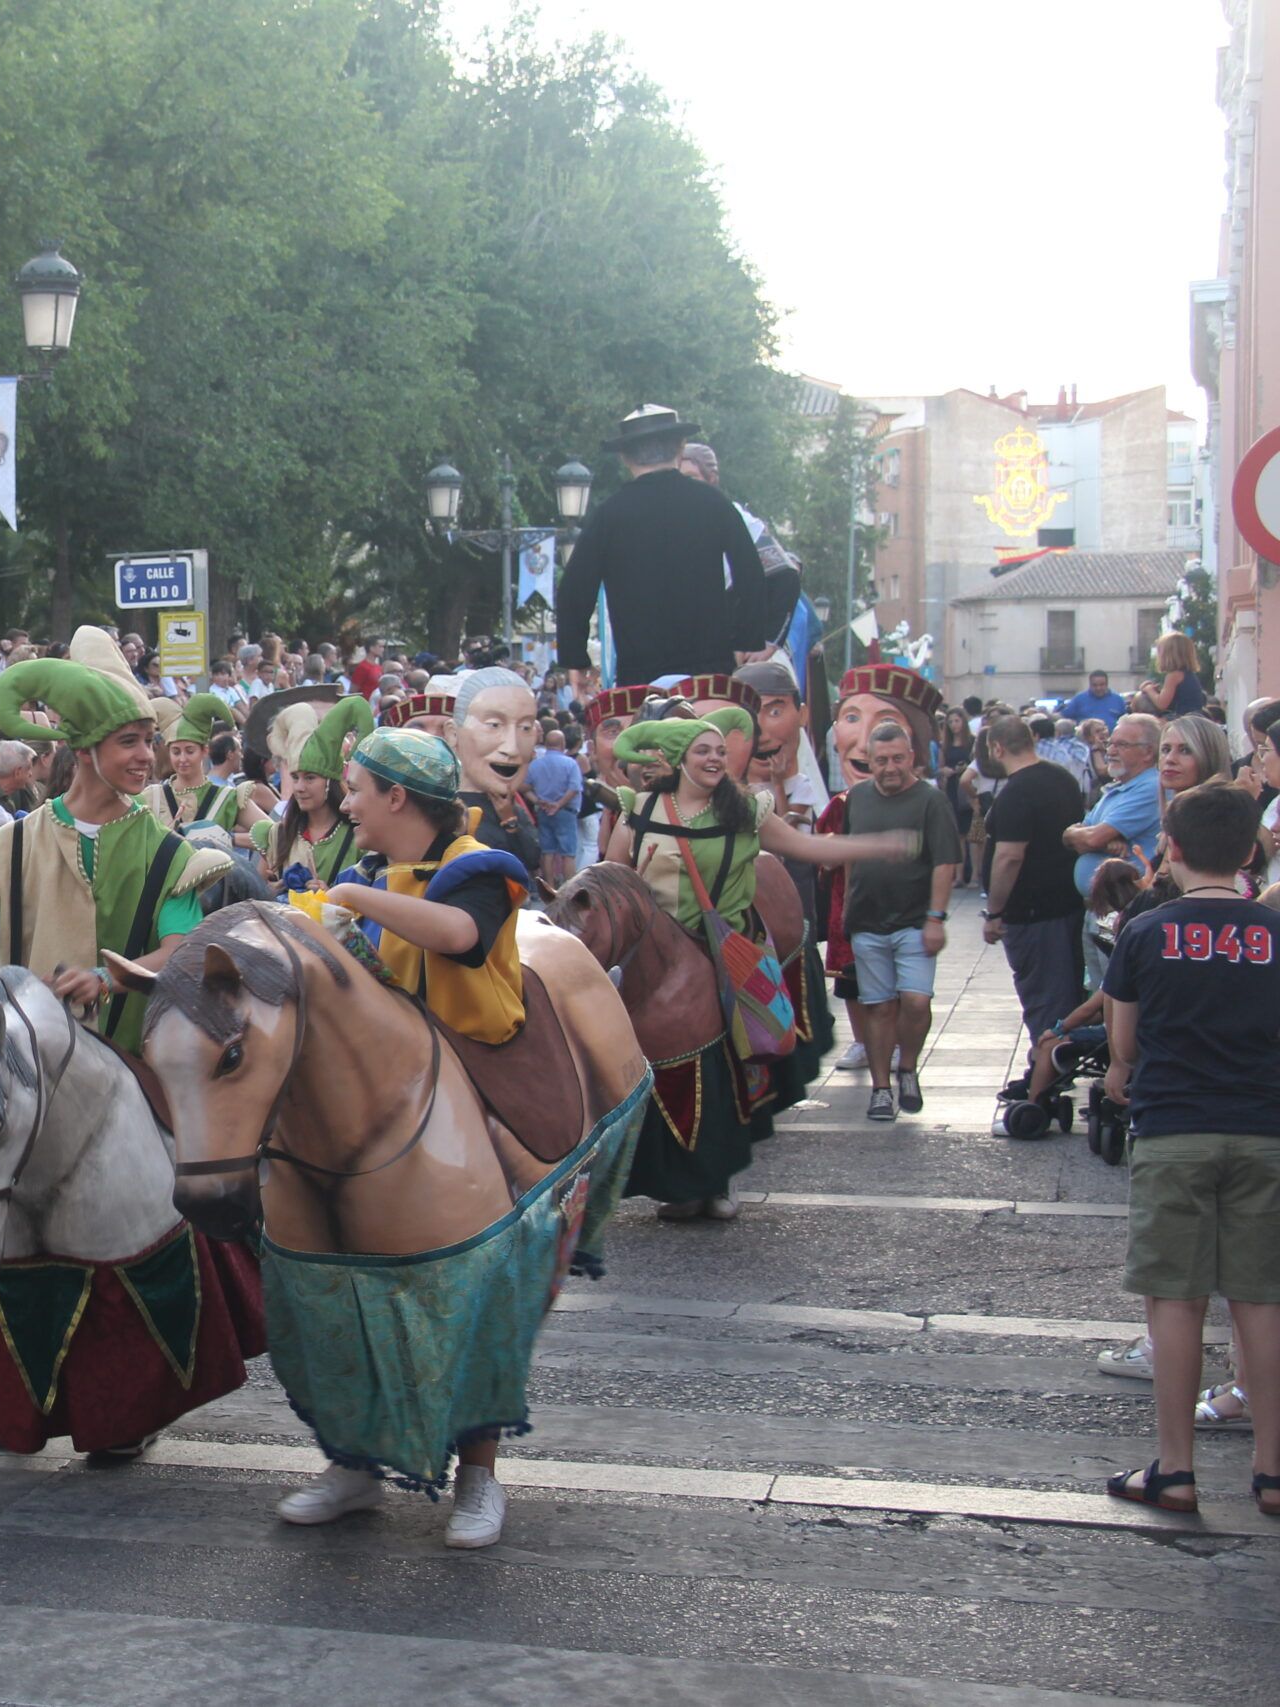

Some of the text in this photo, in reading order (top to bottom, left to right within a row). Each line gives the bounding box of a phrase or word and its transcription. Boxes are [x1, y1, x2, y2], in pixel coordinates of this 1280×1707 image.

[146, 567, 175, 580] CALLE
[129, 585, 179, 600] PRADO
[1161, 923, 1272, 964] 1949
